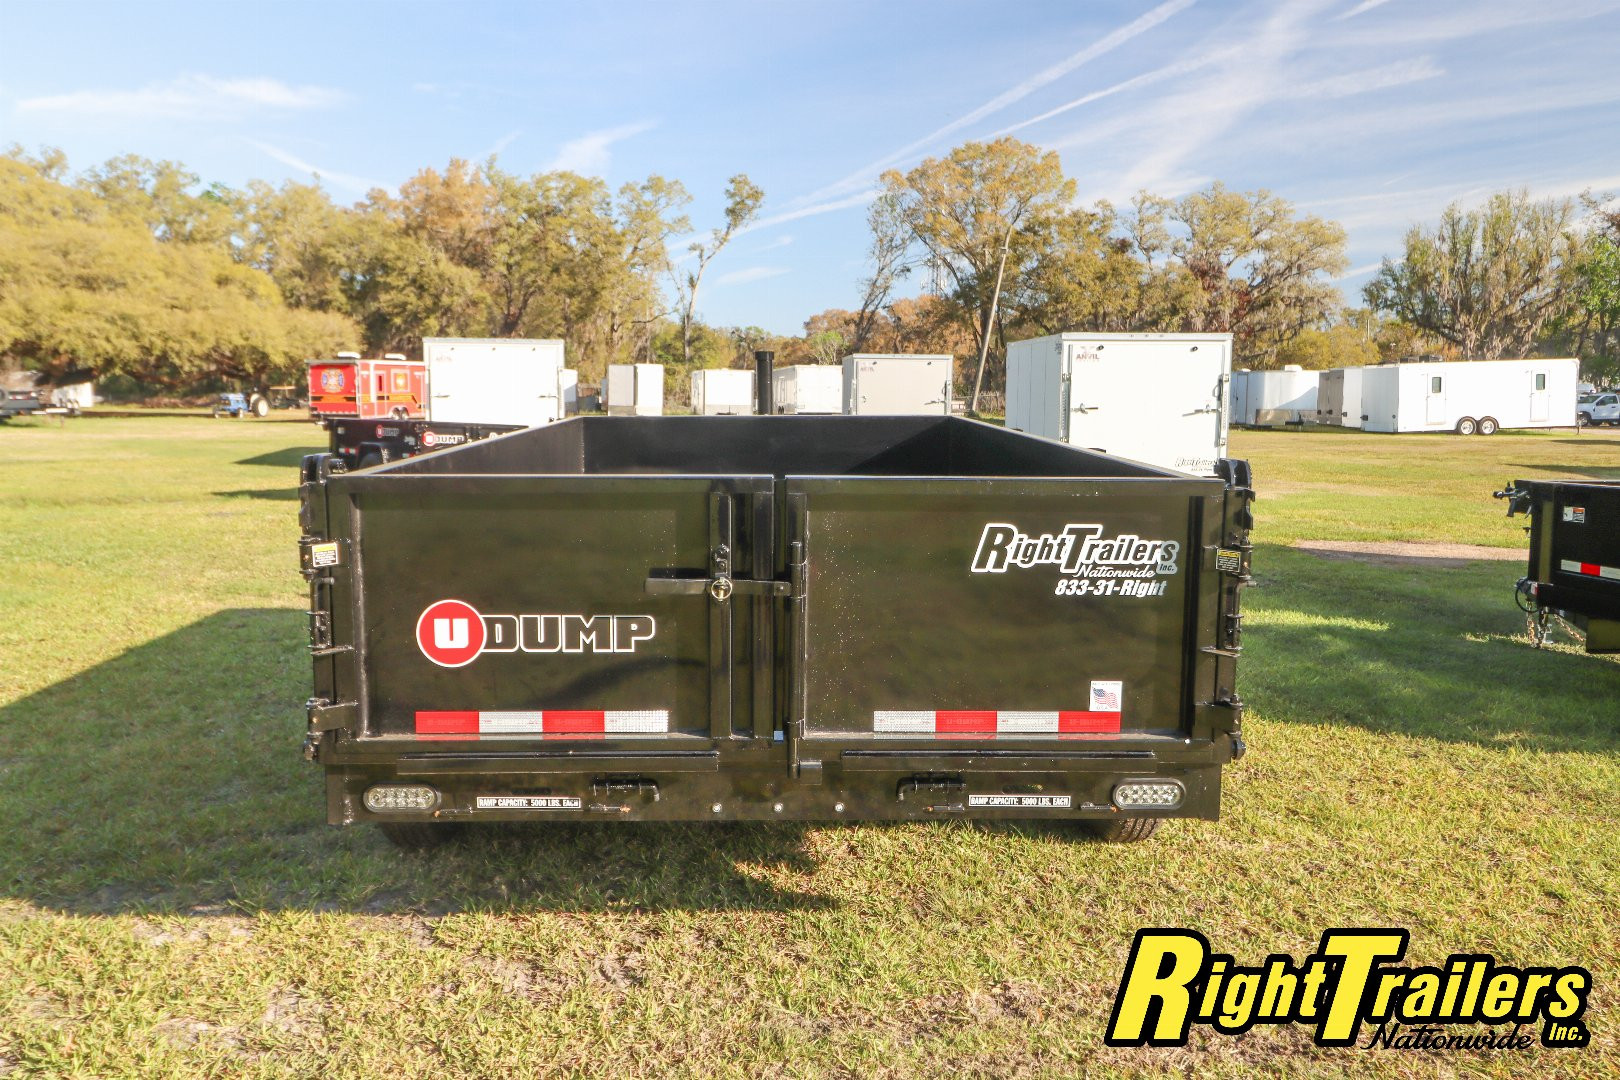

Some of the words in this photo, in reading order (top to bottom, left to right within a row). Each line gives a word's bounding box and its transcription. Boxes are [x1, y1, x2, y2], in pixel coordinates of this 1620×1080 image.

[1072, 563, 1156, 578] Nationwide
[1054, 579, 1167, 597] 833-31-Right
[479, 798, 496, 807] RAMP
[530, 798, 547, 807] 5000
[970, 796, 988, 806] RAMP
[1021, 797, 1037, 806] 5000
[1052, 797, 1069, 806] EACH
